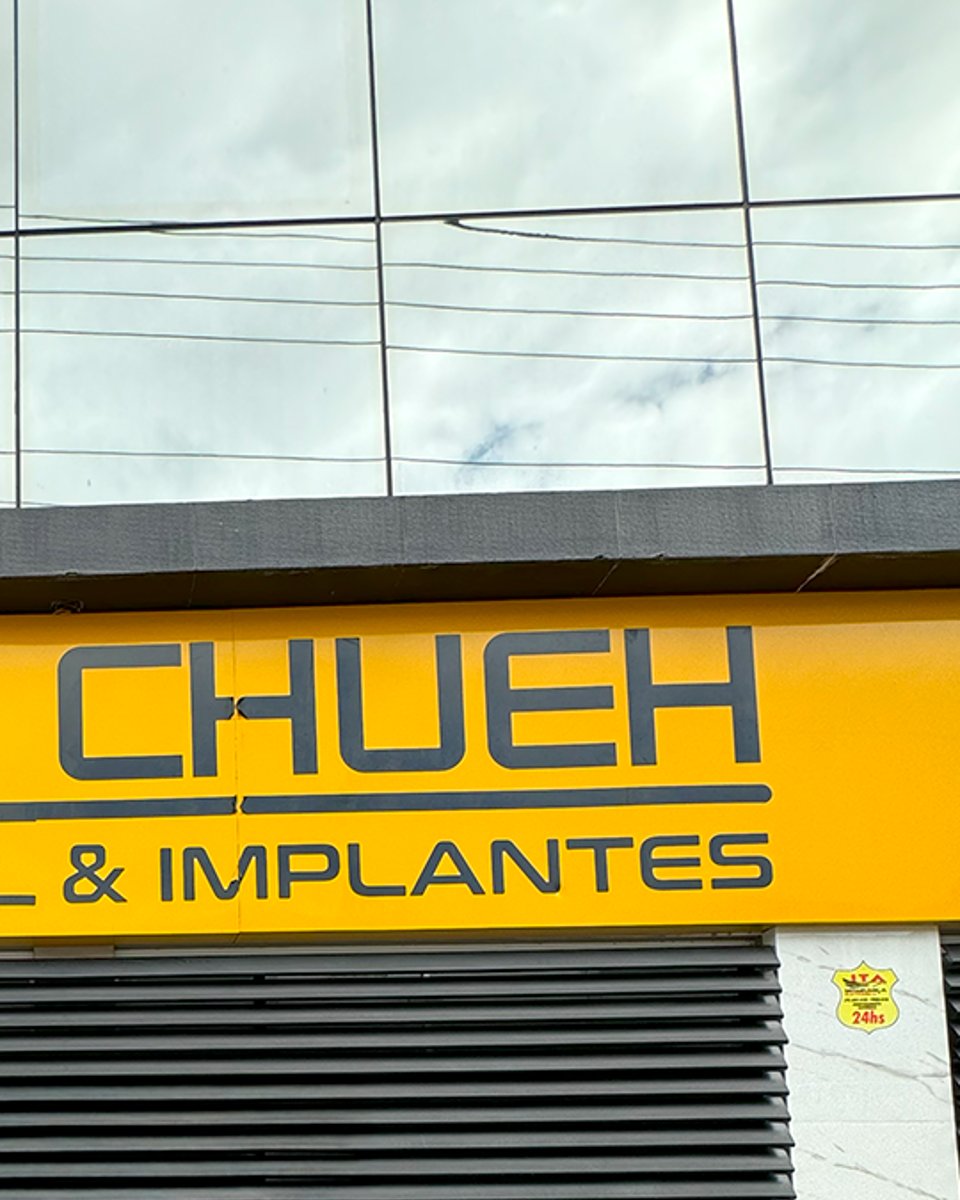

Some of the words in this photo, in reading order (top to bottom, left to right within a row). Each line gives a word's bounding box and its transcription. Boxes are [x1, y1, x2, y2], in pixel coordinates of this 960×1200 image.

[58, 625, 761, 780] CHUEH
[63, 844, 127, 903] &
[160, 834, 773, 901] IMPLANTES
[852, 1010, 885, 1024] 24hs
